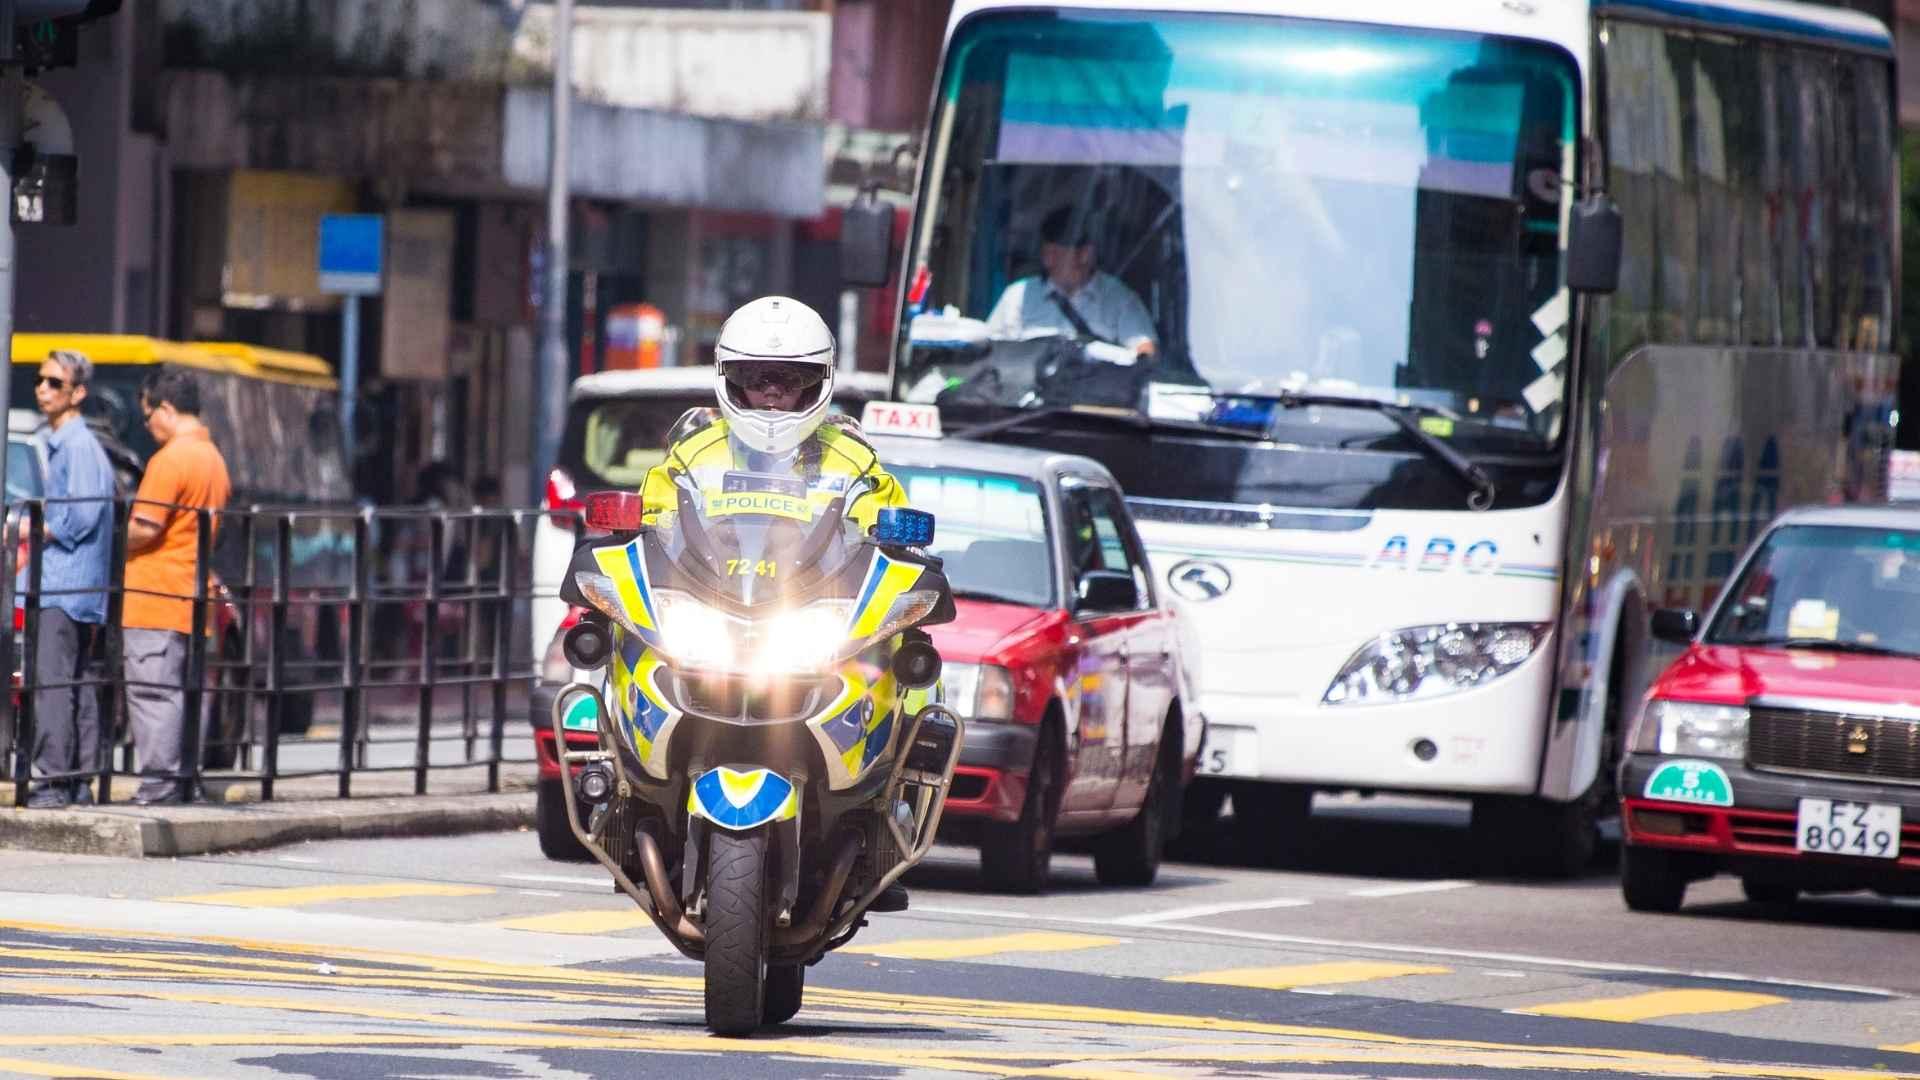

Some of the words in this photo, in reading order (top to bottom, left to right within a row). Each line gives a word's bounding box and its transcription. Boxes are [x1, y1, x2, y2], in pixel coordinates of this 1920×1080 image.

[871, 407, 934, 430] TAXI
[725, 497, 793, 513] POLICE
[1370, 535, 1498, 575] ABC
[726, 559, 777, 578] 7241
[1830, 799, 1870, 828] FZ
[1806, 825, 1890, 857] 8049
